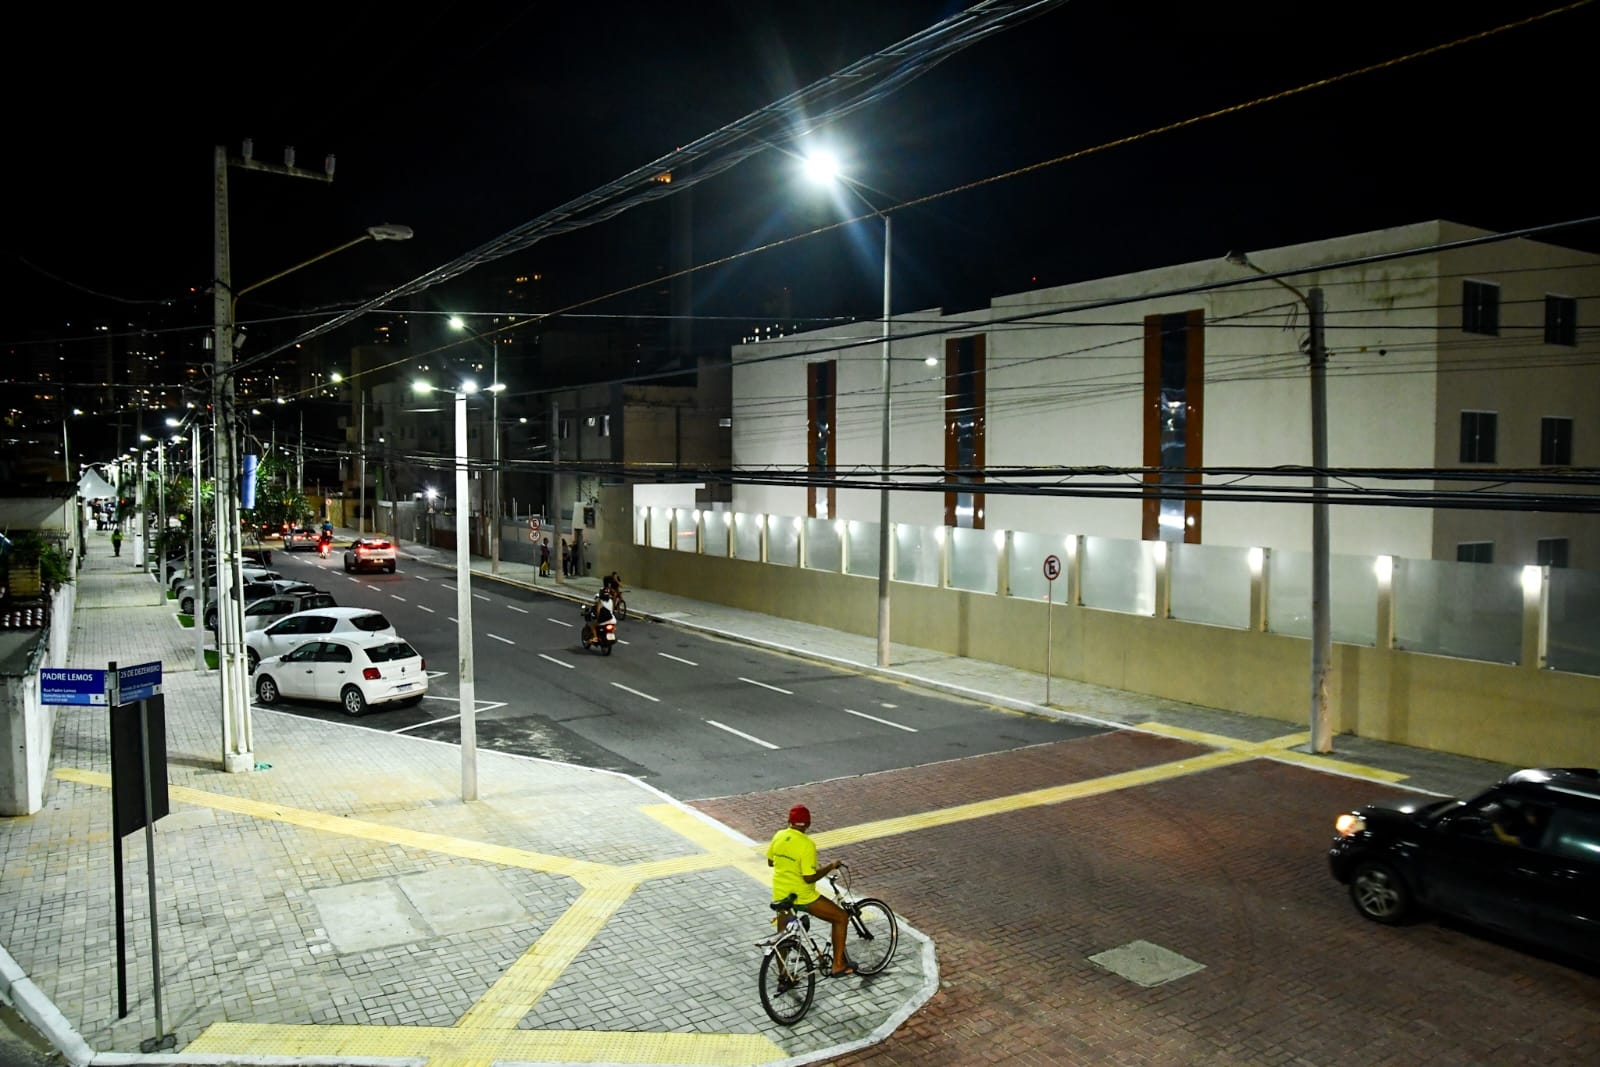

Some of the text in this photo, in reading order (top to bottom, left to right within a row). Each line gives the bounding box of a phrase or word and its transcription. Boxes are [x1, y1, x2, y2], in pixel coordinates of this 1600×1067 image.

[42, 672, 93, 682] PADRE LEMOS
[120, 671, 126, 679] 25
[134, 664, 160, 676] DEZEMBRO
